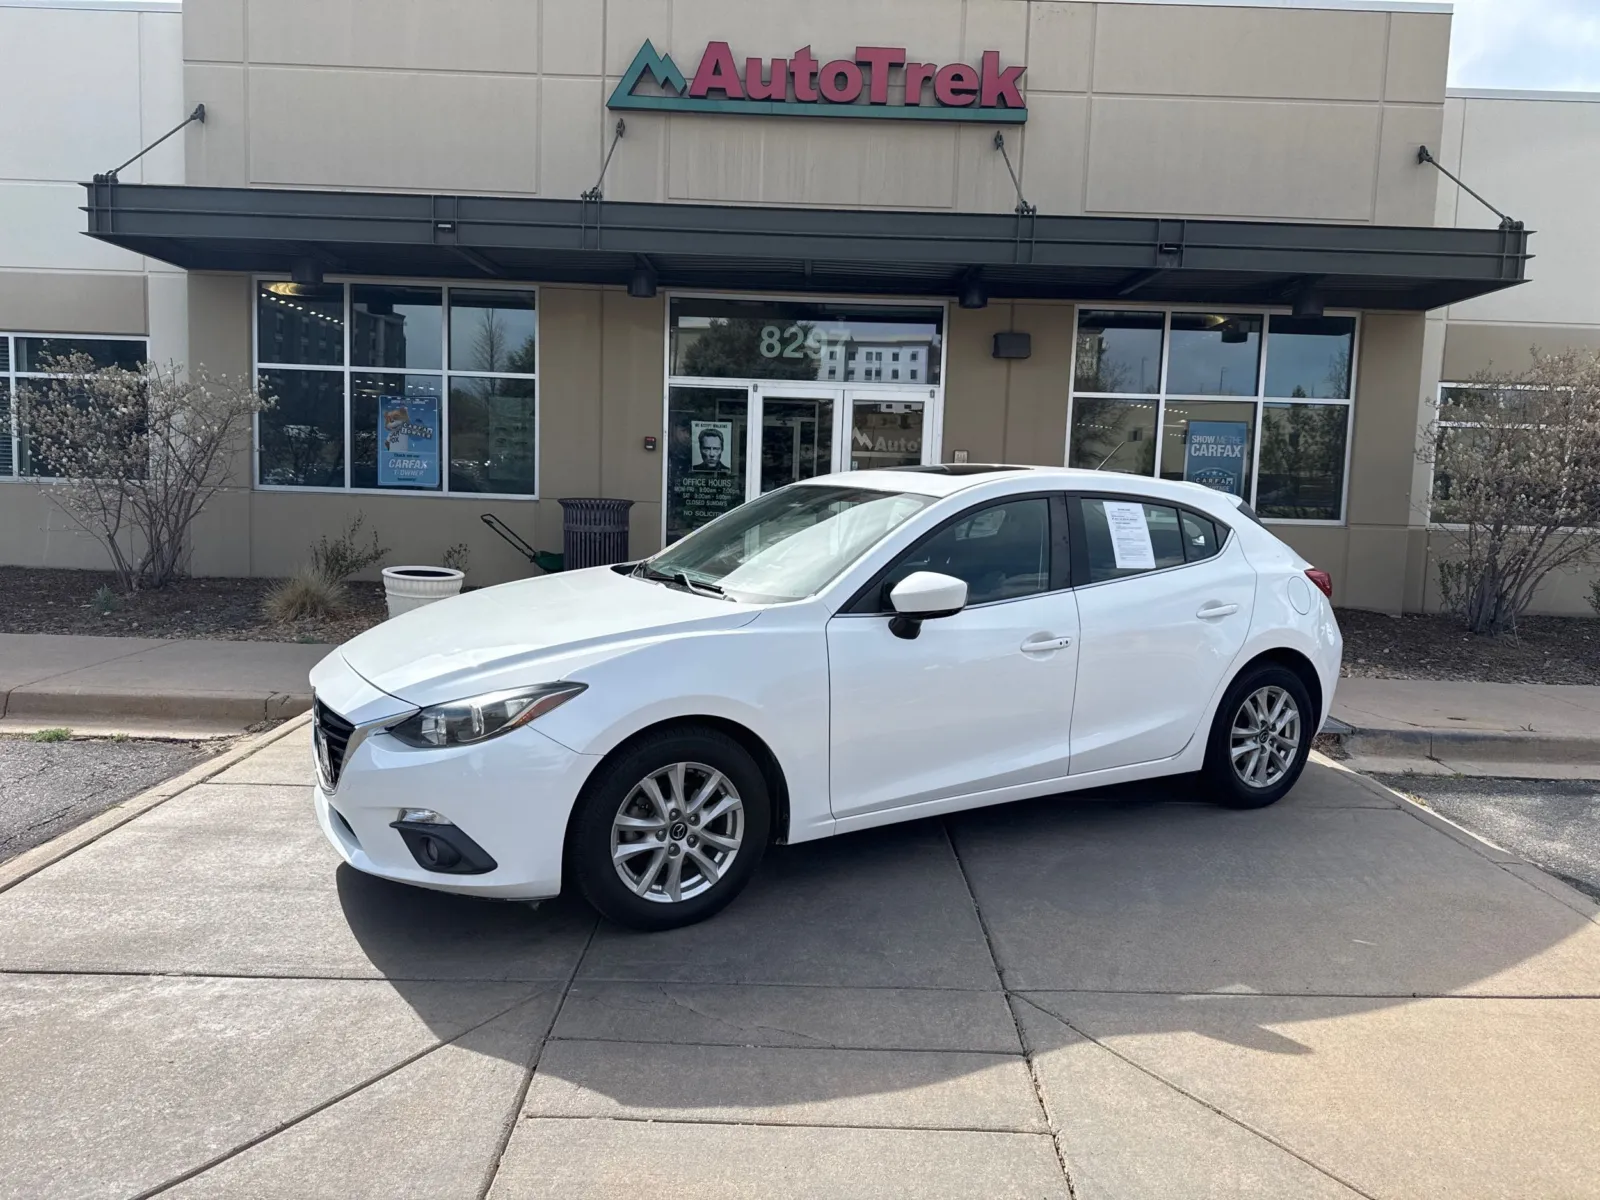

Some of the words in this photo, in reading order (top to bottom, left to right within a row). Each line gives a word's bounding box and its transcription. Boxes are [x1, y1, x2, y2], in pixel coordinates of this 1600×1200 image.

[689, 41, 1028, 109] AutoTrek
[759, 325, 851, 360] 8297
[1191, 435, 1216, 444] SHOW
[1191, 444, 1242, 457] CARFAX
[388, 459, 428, 468] CARFAX
[682, 478, 706, 486] OFFICE
[708, 479, 732, 488] HOURS
